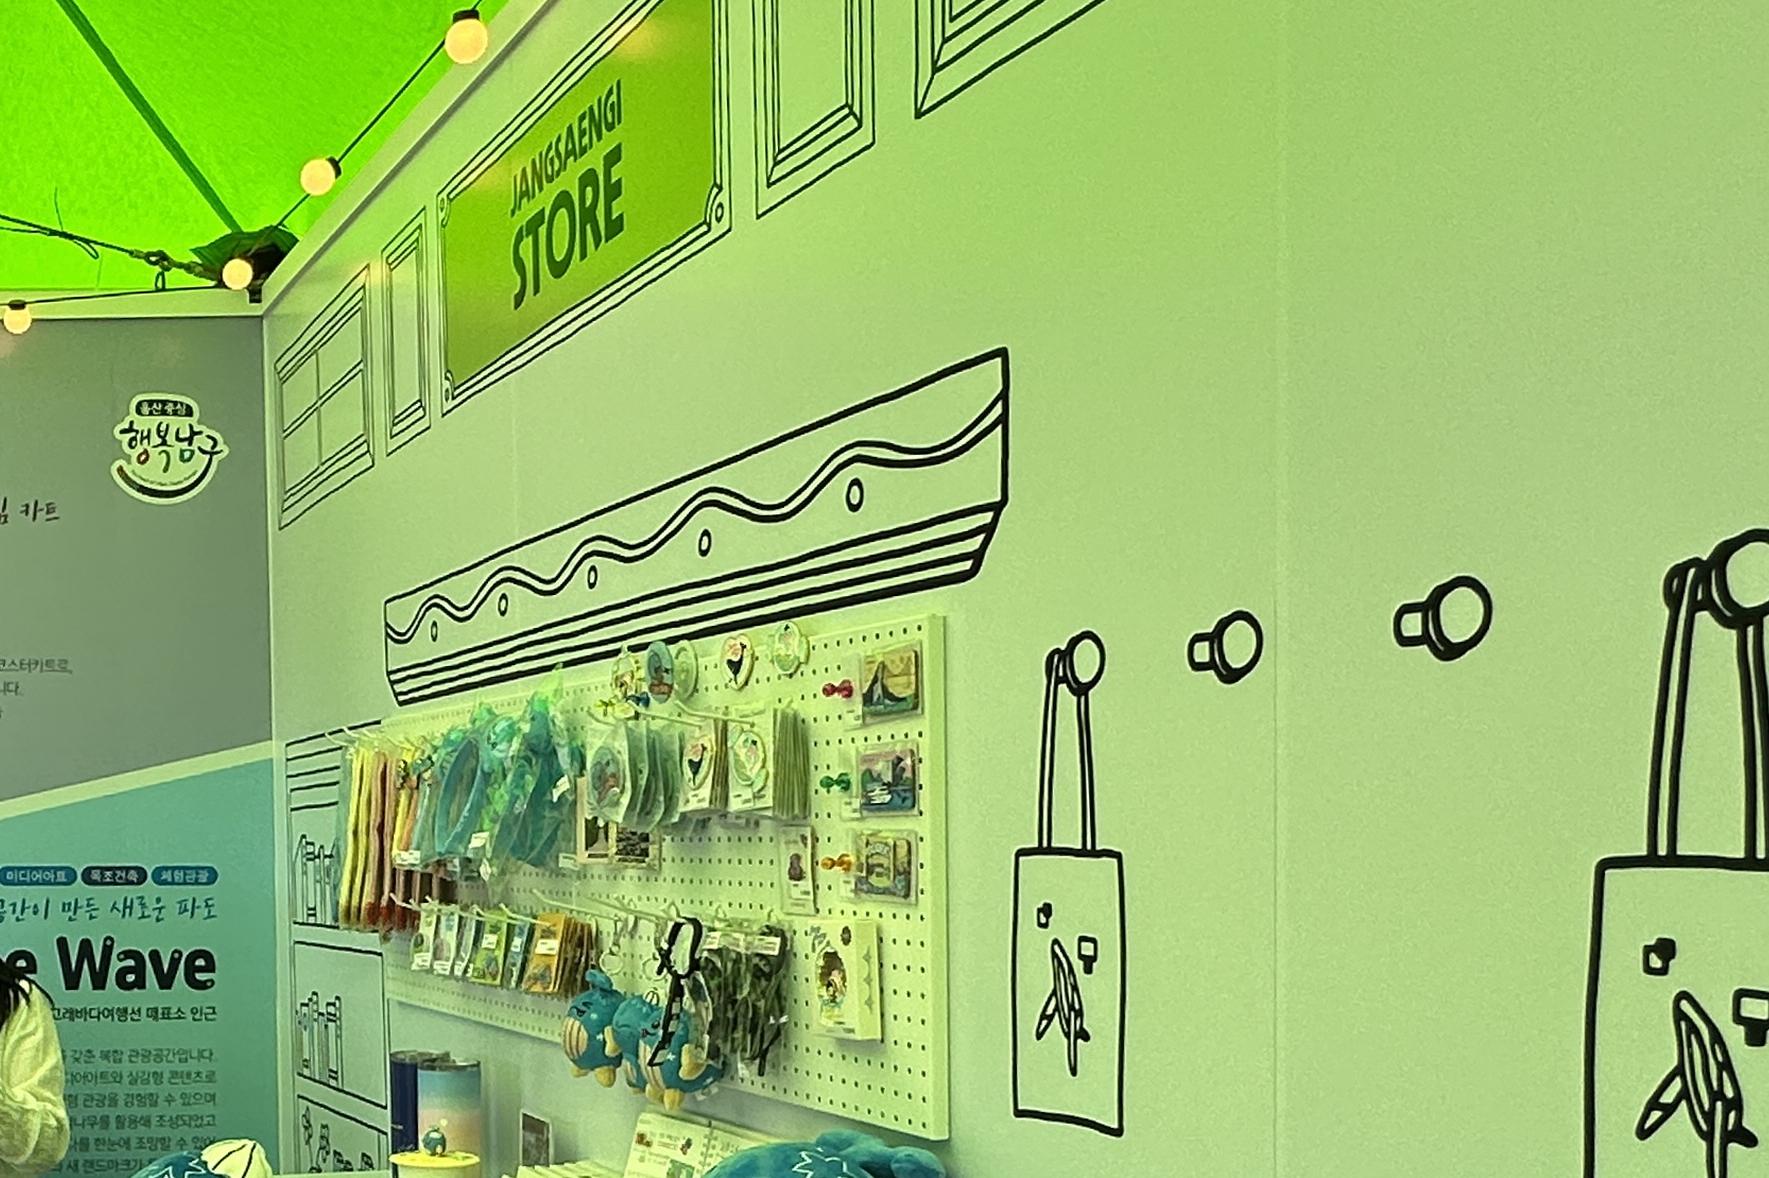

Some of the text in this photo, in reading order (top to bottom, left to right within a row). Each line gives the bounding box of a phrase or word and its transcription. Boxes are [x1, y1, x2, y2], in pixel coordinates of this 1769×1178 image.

[510, 78, 623, 218] JANGSAENGI
[512, 142, 625, 310] STORE
[118, 420, 224, 475] 행복남구
[19, 498, 62, 522] 카트
[61, 897, 100, 922] 만든
[110, 894, 166, 923] 새로운
[177, 896, 218, 921] 파도
[55, 935, 217, 991] Wave
[190, 1006, 218, 1022] 인근
